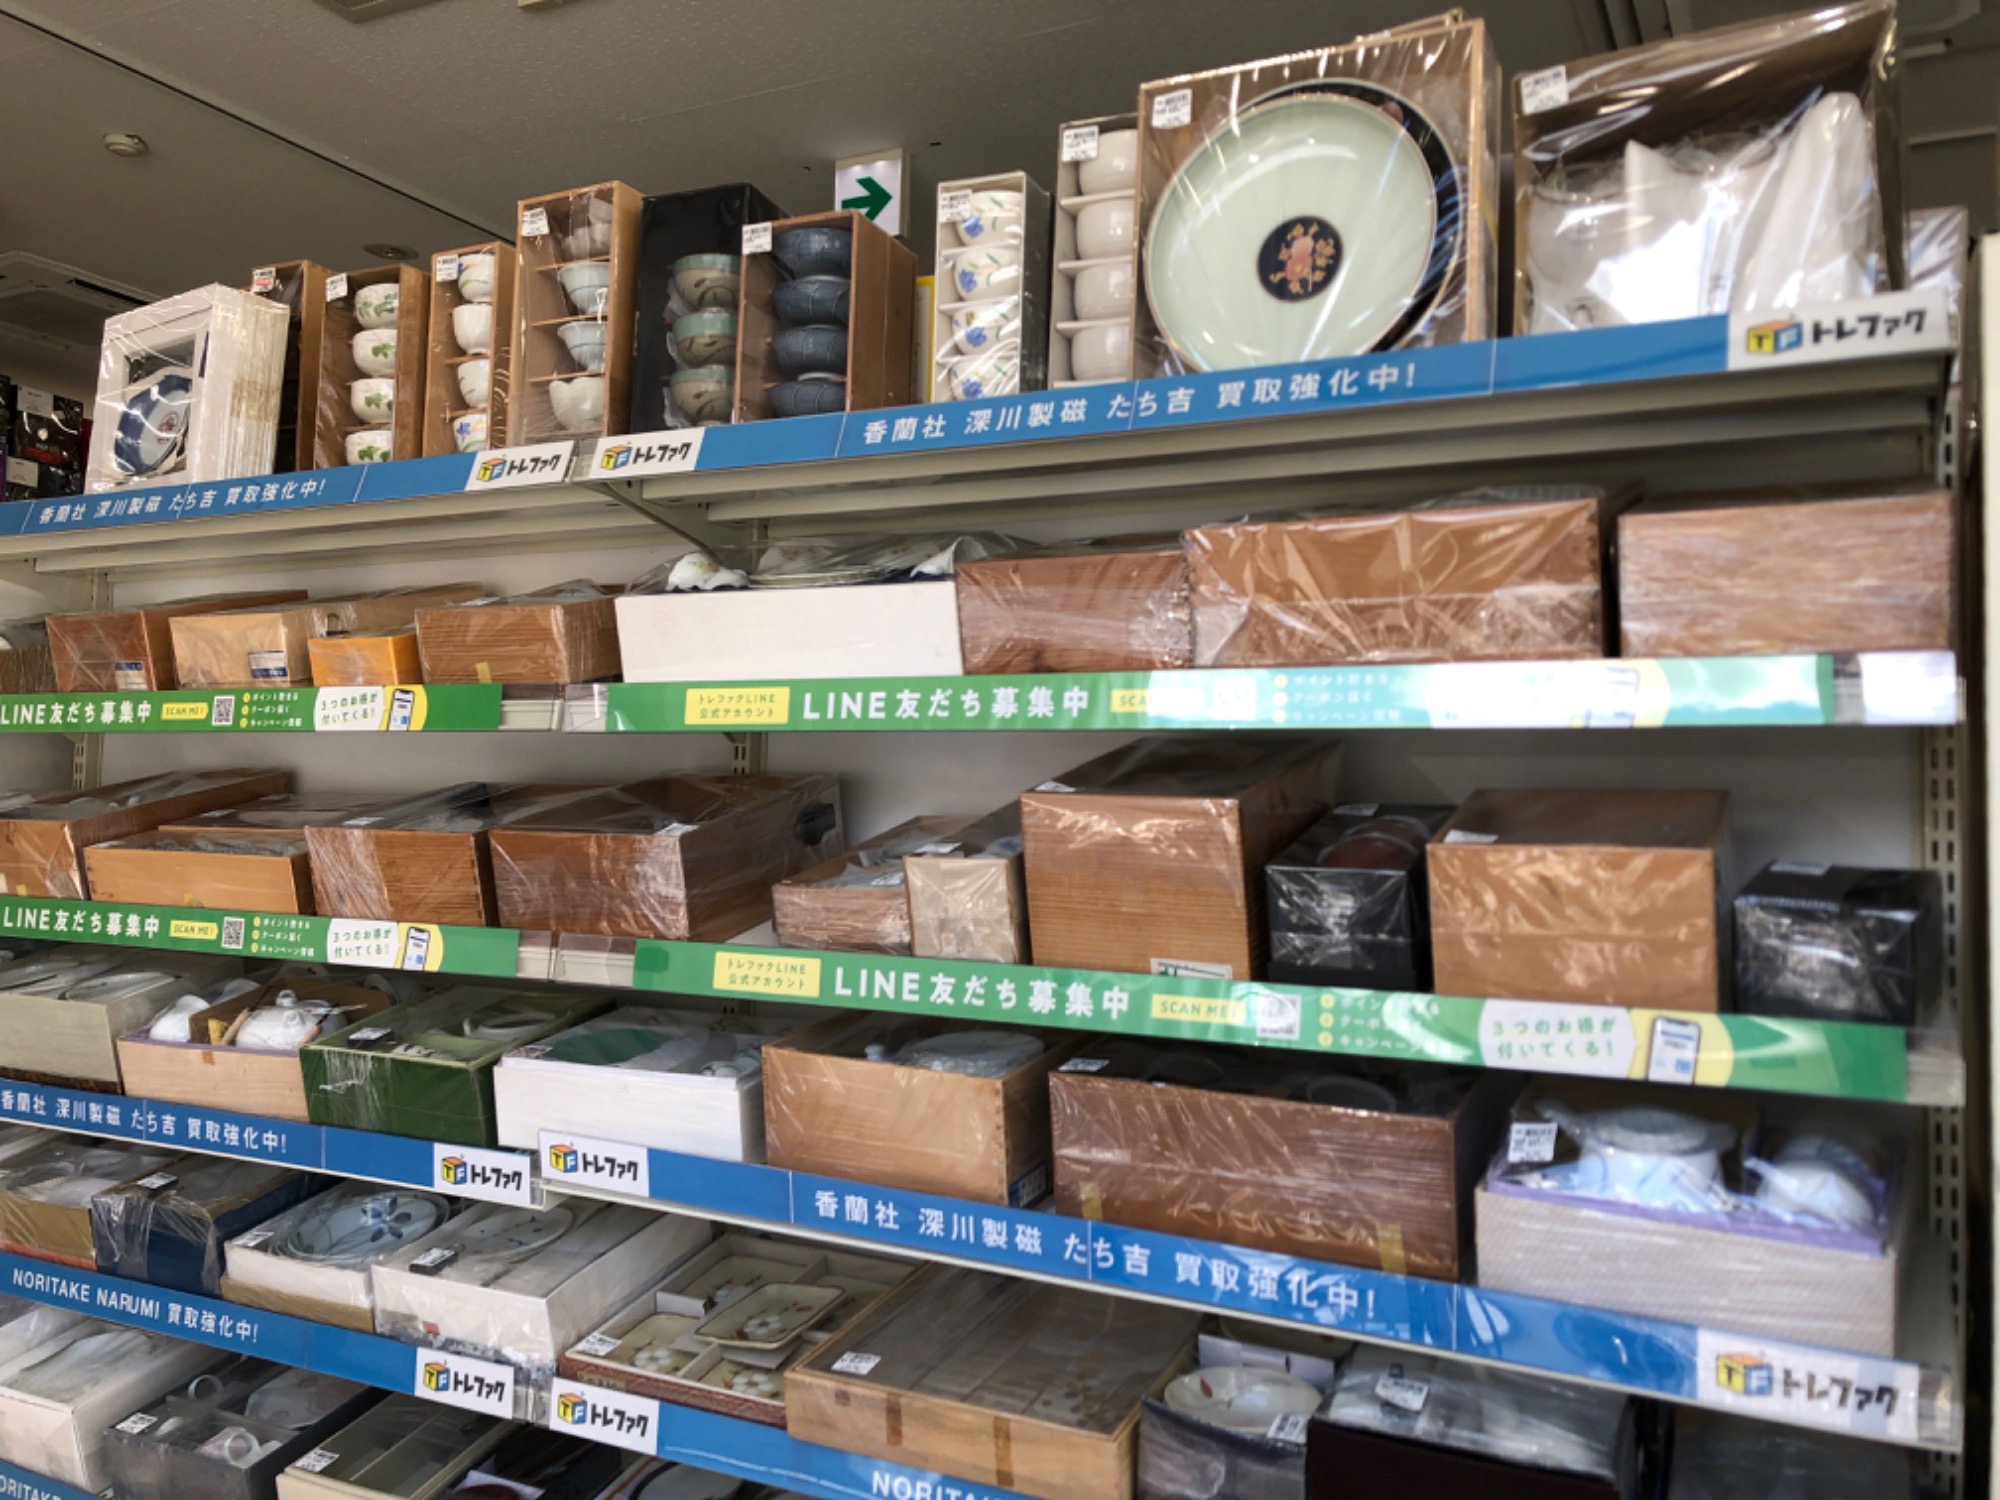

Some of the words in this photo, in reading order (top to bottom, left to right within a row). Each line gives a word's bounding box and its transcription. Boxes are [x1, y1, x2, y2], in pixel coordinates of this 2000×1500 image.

[1813, 308, 1927, 344] トレファク
[863, 413, 947, 444] 香蘭社
[963, 399, 1087, 434] 深川製磁
[1107, 388, 1195, 417] たち吉
[1217, 362, 1416, 409] 買取強化中!
[507, 453, 561, 476] トレファク
[632, 442, 692, 464] トレファク
[169, 489, 217, 511] たち吉
[1, 700, 151, 725] LINE友だち募集中
[803, 685, 1090, 720] LINE友だち募集中
[4, 905, 159, 939] LINE友だち募集中
[835, 966, 1129, 1019] LINE友だち募集中
[1160, 999, 1201, 1016] SCAN
[1493, 1015, 1616, 1038] 3つのお得が
[1497, 1039, 1614, 1060] 付いてくる!
[131, 1108, 176, 1136] たち吉
[471, 1164, 522, 1191] トレファク
[582, 1152, 638, 1181] トレファク
[815, 1189, 900, 1231] 香蘭社
[918, 1206, 1043, 1256] 深川製磁
[1063, 1232, 1151, 1277] たち吉
[1175, 1251, 1376, 1318] 買取強化中!
[13, 1267, 91, 1302] NORITAKE
[97, 1287, 160, 1320] NARUMI
[168, 1302, 258, 1343] 買取強化中!
[453, 1371, 505, 1402] トレファク
[1783, 1368, 1897, 1416] トレファク
[590, 1403, 649, 1437] トレファク
